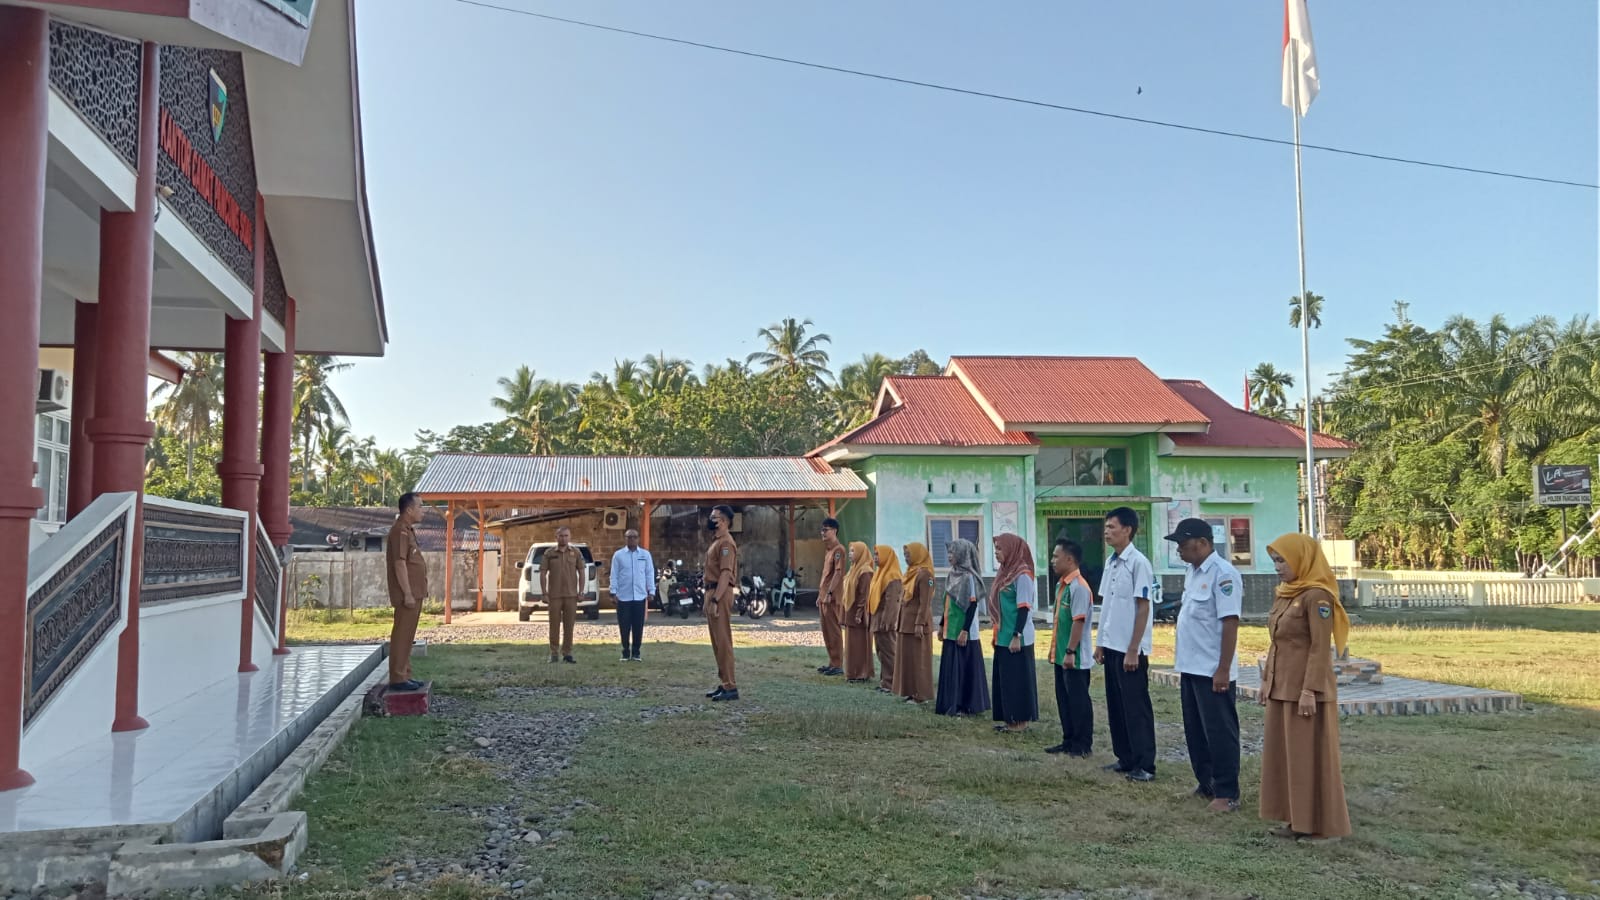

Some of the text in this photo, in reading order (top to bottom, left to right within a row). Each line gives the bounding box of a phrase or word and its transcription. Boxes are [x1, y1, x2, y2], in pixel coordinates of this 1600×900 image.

[160, 106, 191, 181] KANTOR
[191, 144, 214, 207] CAMAT
[1546, 468, 1561, 481] LA
